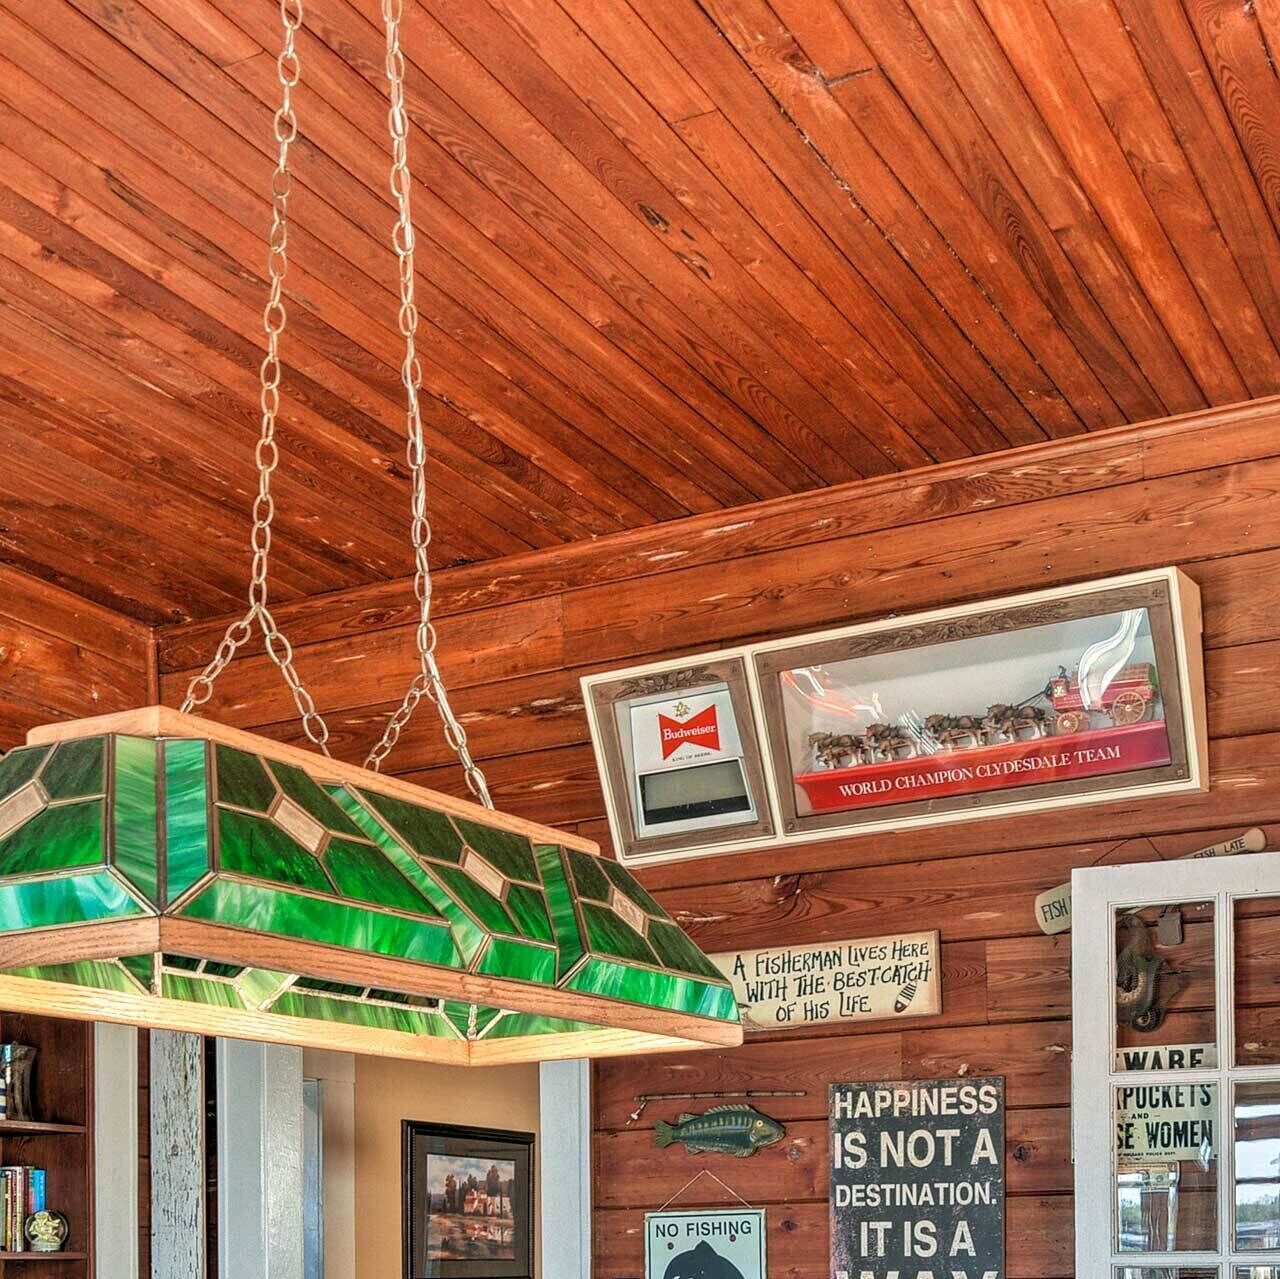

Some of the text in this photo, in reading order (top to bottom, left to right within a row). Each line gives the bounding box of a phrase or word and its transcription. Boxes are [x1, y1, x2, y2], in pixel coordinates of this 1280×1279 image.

[663, 725, 717, 740] Budweiser
[839, 745, 1121, 797] WORLD CHAMPION CLYDESDALE TEAM
[1224, 838, 1246, 853] LATE
[1041, 898, 1069, 923] FISH
[733, 939, 929, 981] A FISHERMAN LIVES HERE
[746, 979, 788, 1003] WITH
[793, 974, 825, 997] THE
[833, 966, 879, 991] BEST
[776, 991, 872, 1022] OF HIS LIFE
[834, 1085, 998, 1119] HAPPINESS
[1131, 1112, 1149, 1120] AND
[834, 1128, 998, 1169] IS NOT A
[1145, 1120, 1213, 1149] WOMEN
[835, 1181, 997, 1207] DESTINATION.
[655, 1220, 752, 1238] NO FISHING
[860, 1220, 977, 1258] IT IS A
